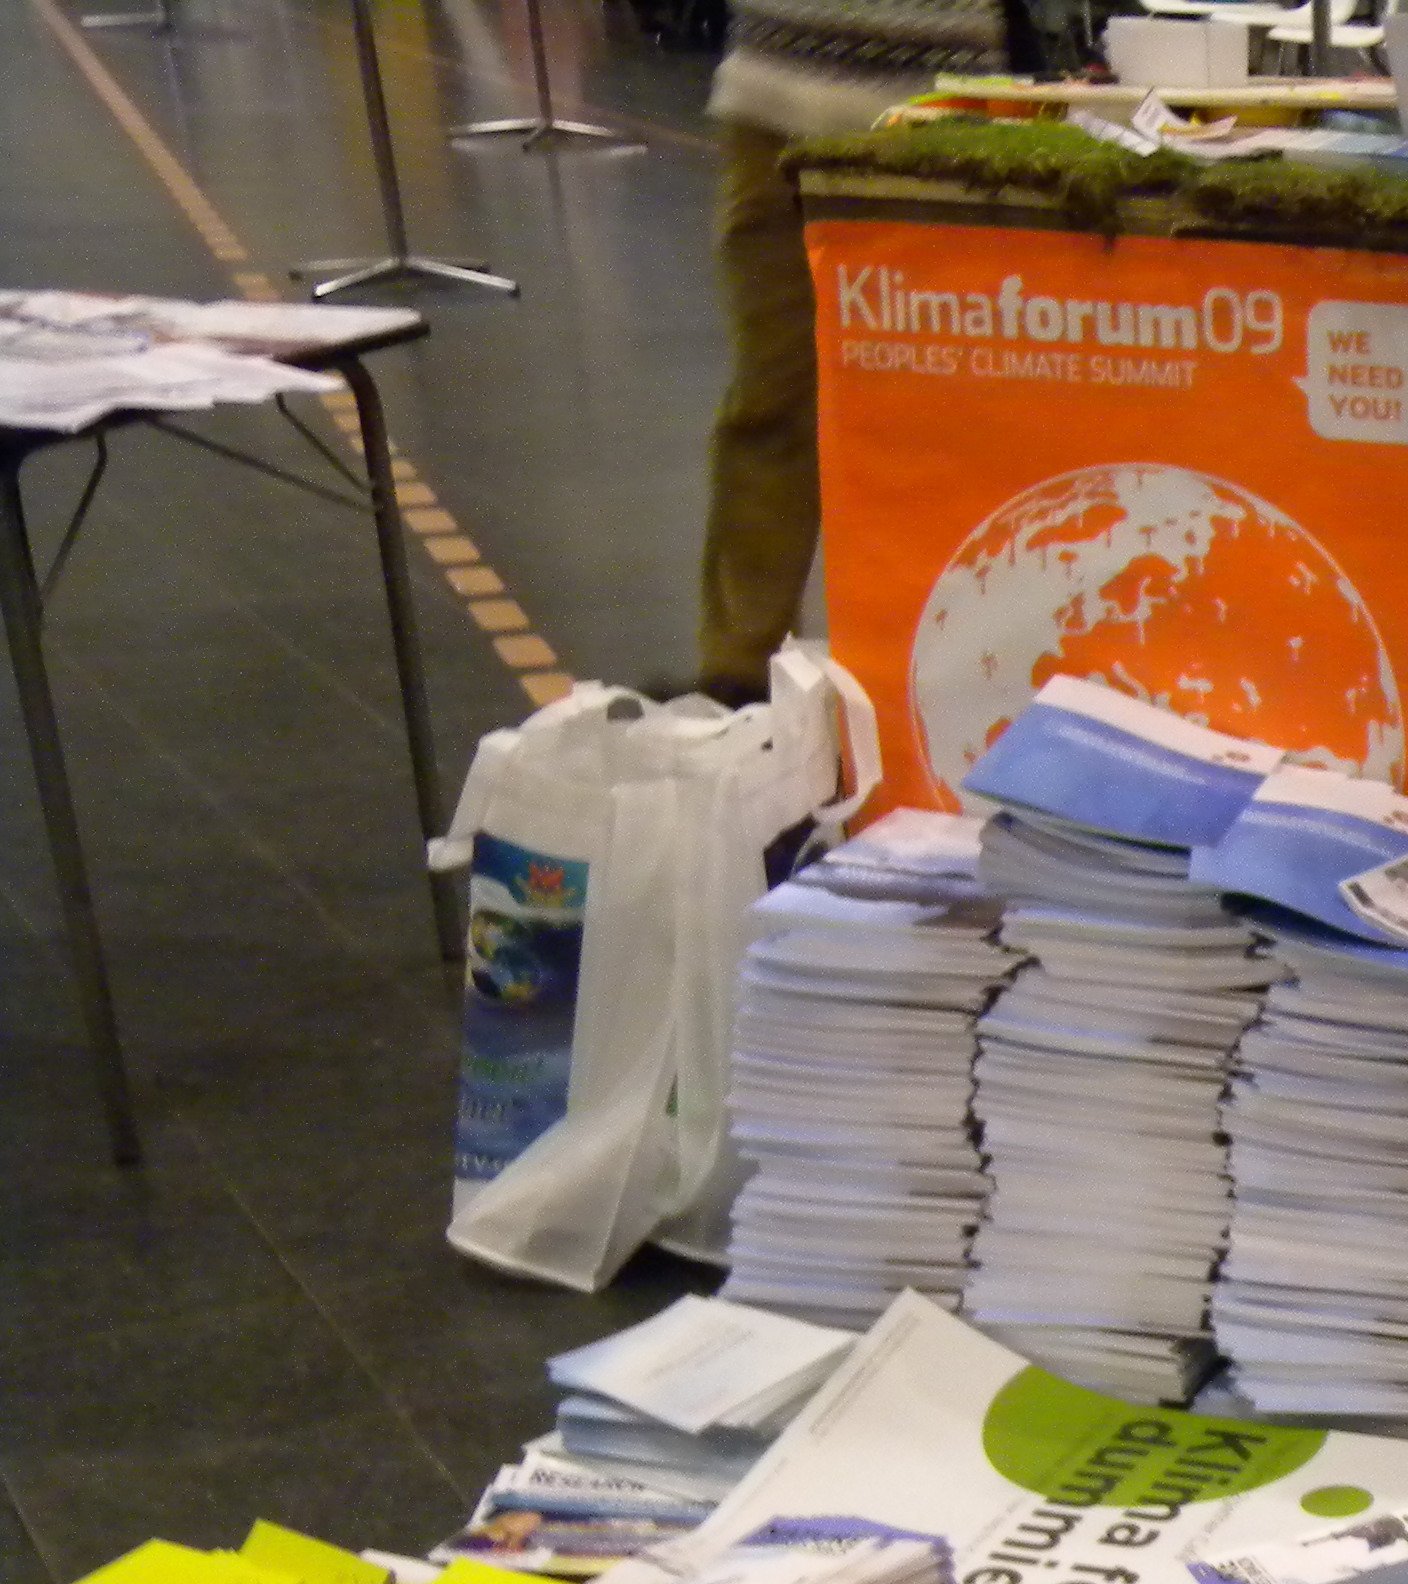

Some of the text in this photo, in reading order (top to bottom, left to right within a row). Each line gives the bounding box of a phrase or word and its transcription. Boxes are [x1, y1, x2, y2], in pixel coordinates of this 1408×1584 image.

[837, 264, 1284, 355] Klimaforum09
[1327, 331, 1371, 355] WE
[970, 348, 1081, 383] CLIMATE
[1090, 356, 1197, 389] SUMMIT
[1327, 364, 1404, 390] NEED
[1330, 395, 1402, 422] YOU!
[1097, 1430, 1267, 1548] Klima
